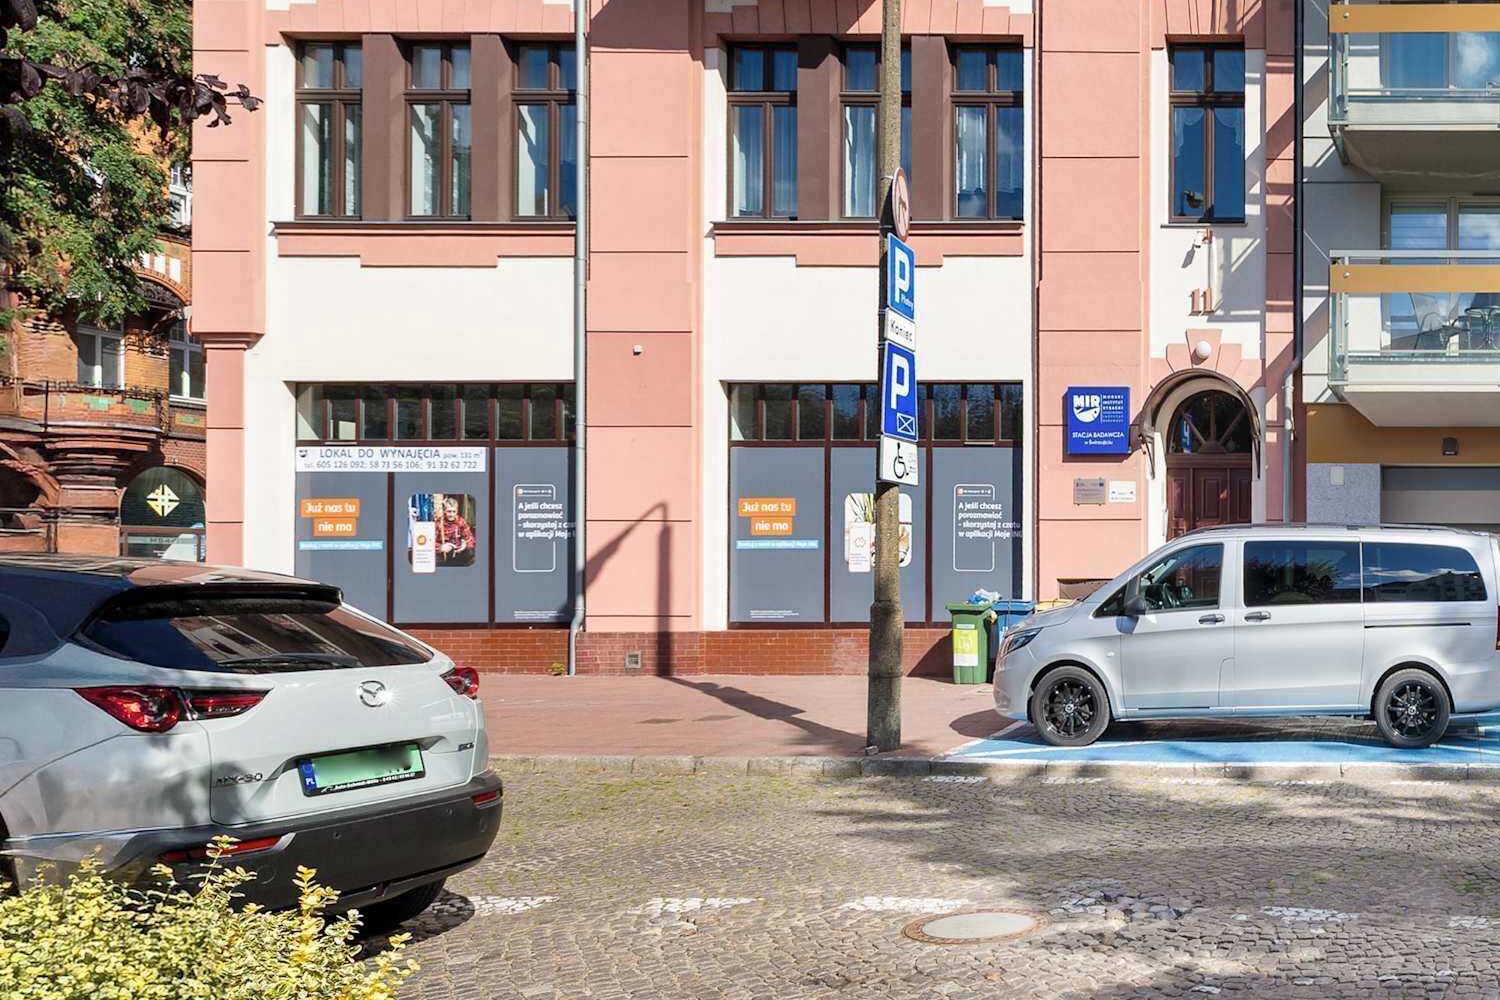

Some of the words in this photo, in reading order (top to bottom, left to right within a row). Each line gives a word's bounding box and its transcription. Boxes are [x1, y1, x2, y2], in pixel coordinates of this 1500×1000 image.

[895, 247, 910, 303] P
[1189, 288, 1213, 314] 11
[890, 319, 912, 342] Koniec
[891, 353, 909, 410] P
[1073, 395, 1100, 408] MIR
[319, 449, 352, 458] LOKAL
[358, 449, 374, 458] DO
[380, 449, 440, 460] WYNAJĘCIA
[316, 461, 331, 469] 605
[369, 461, 380, 469] 58
[427, 461, 437, 469] 91
[439, 461, 449, 469] 32
[463, 461, 478, 469] 722
[306, 502, 323, 513] Już
[325, 504, 343, 513] nas
[344, 503, 356, 513] tu
[540, 502, 563, 510] chcesz
[743, 502, 760, 512] Już
[761, 504, 779, 512] nas
[781, 503, 792, 512] tu
[958, 502, 964, 510] A
[980, 502, 1002, 510] chcesz
[318, 521, 334, 532] nie
[336, 523, 352, 532] ma
[755, 520, 770, 531] nie
[772, 522, 788, 531] ma
[994, 530, 1010, 539] Moje
[306, 777, 315, 786] PL
